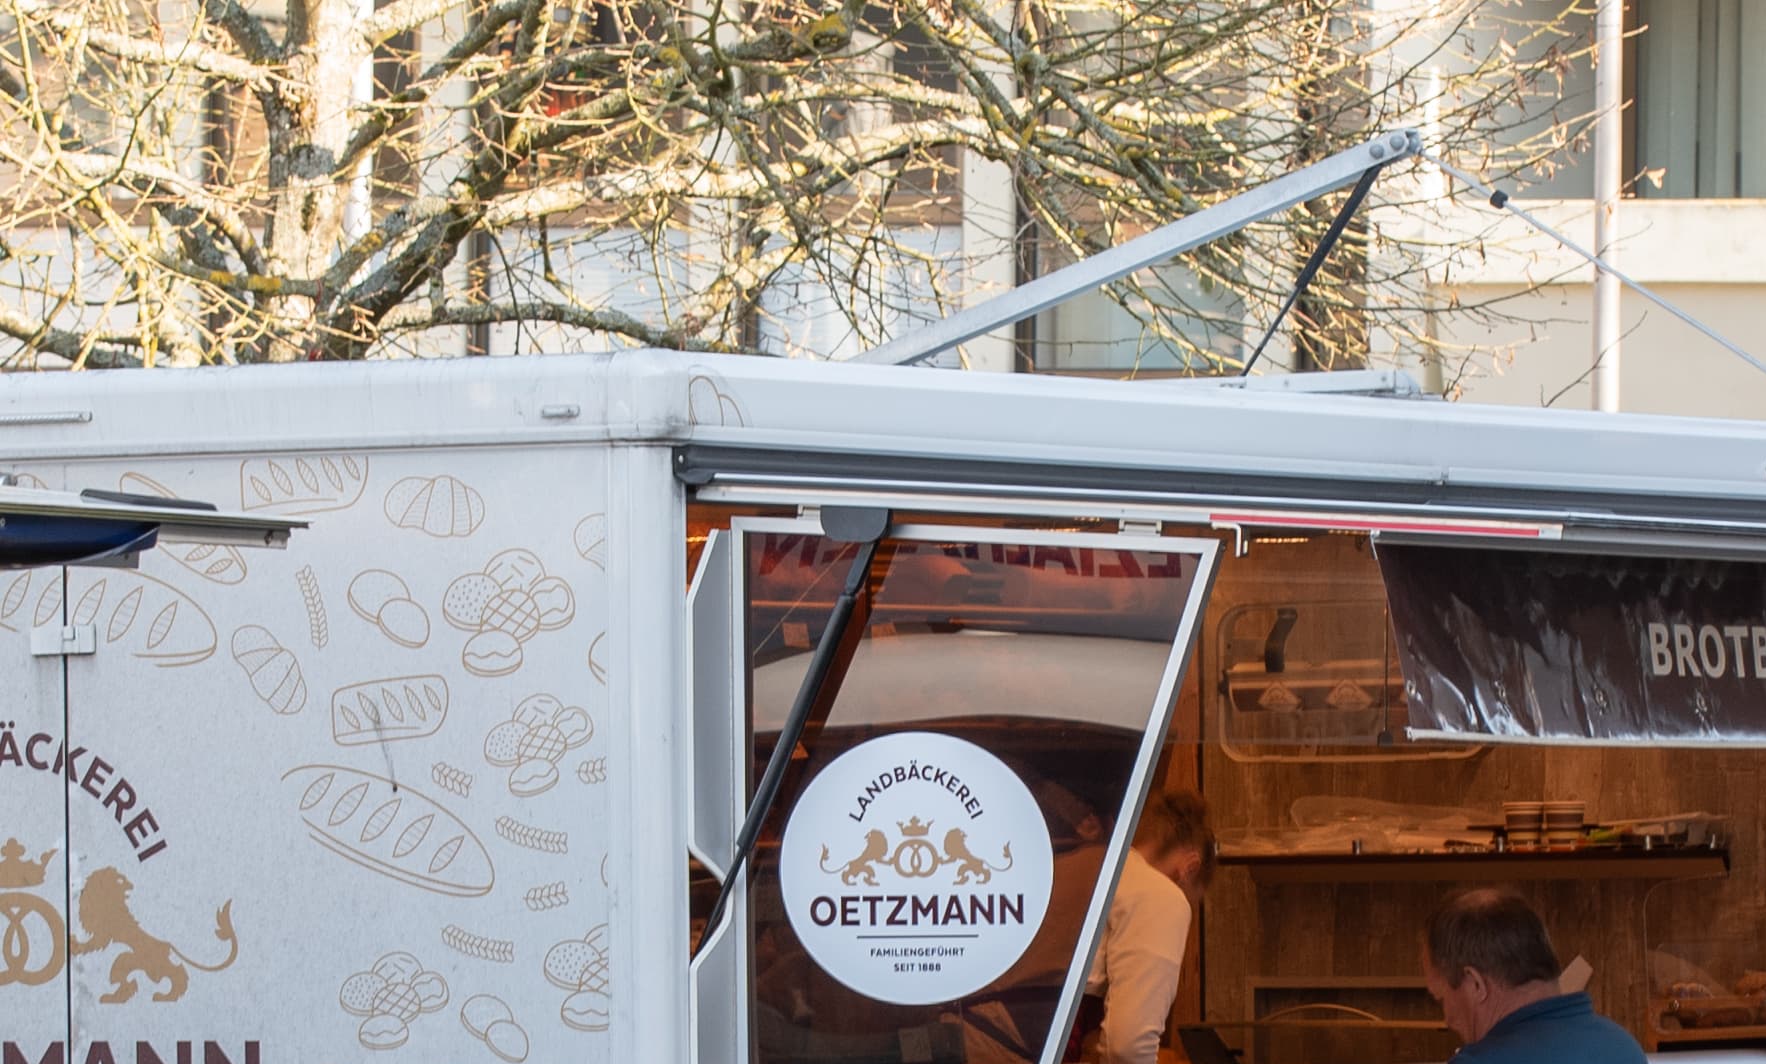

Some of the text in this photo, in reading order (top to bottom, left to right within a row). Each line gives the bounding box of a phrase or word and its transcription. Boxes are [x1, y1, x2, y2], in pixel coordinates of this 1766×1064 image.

[849, 760, 984, 823] LANDBÄCKEREI
[810, 894, 1024, 927] OETZMANN
[870, 946, 965, 957] FAMILIENGEFÜHRT
[894, 962, 915, 972] SEIT
